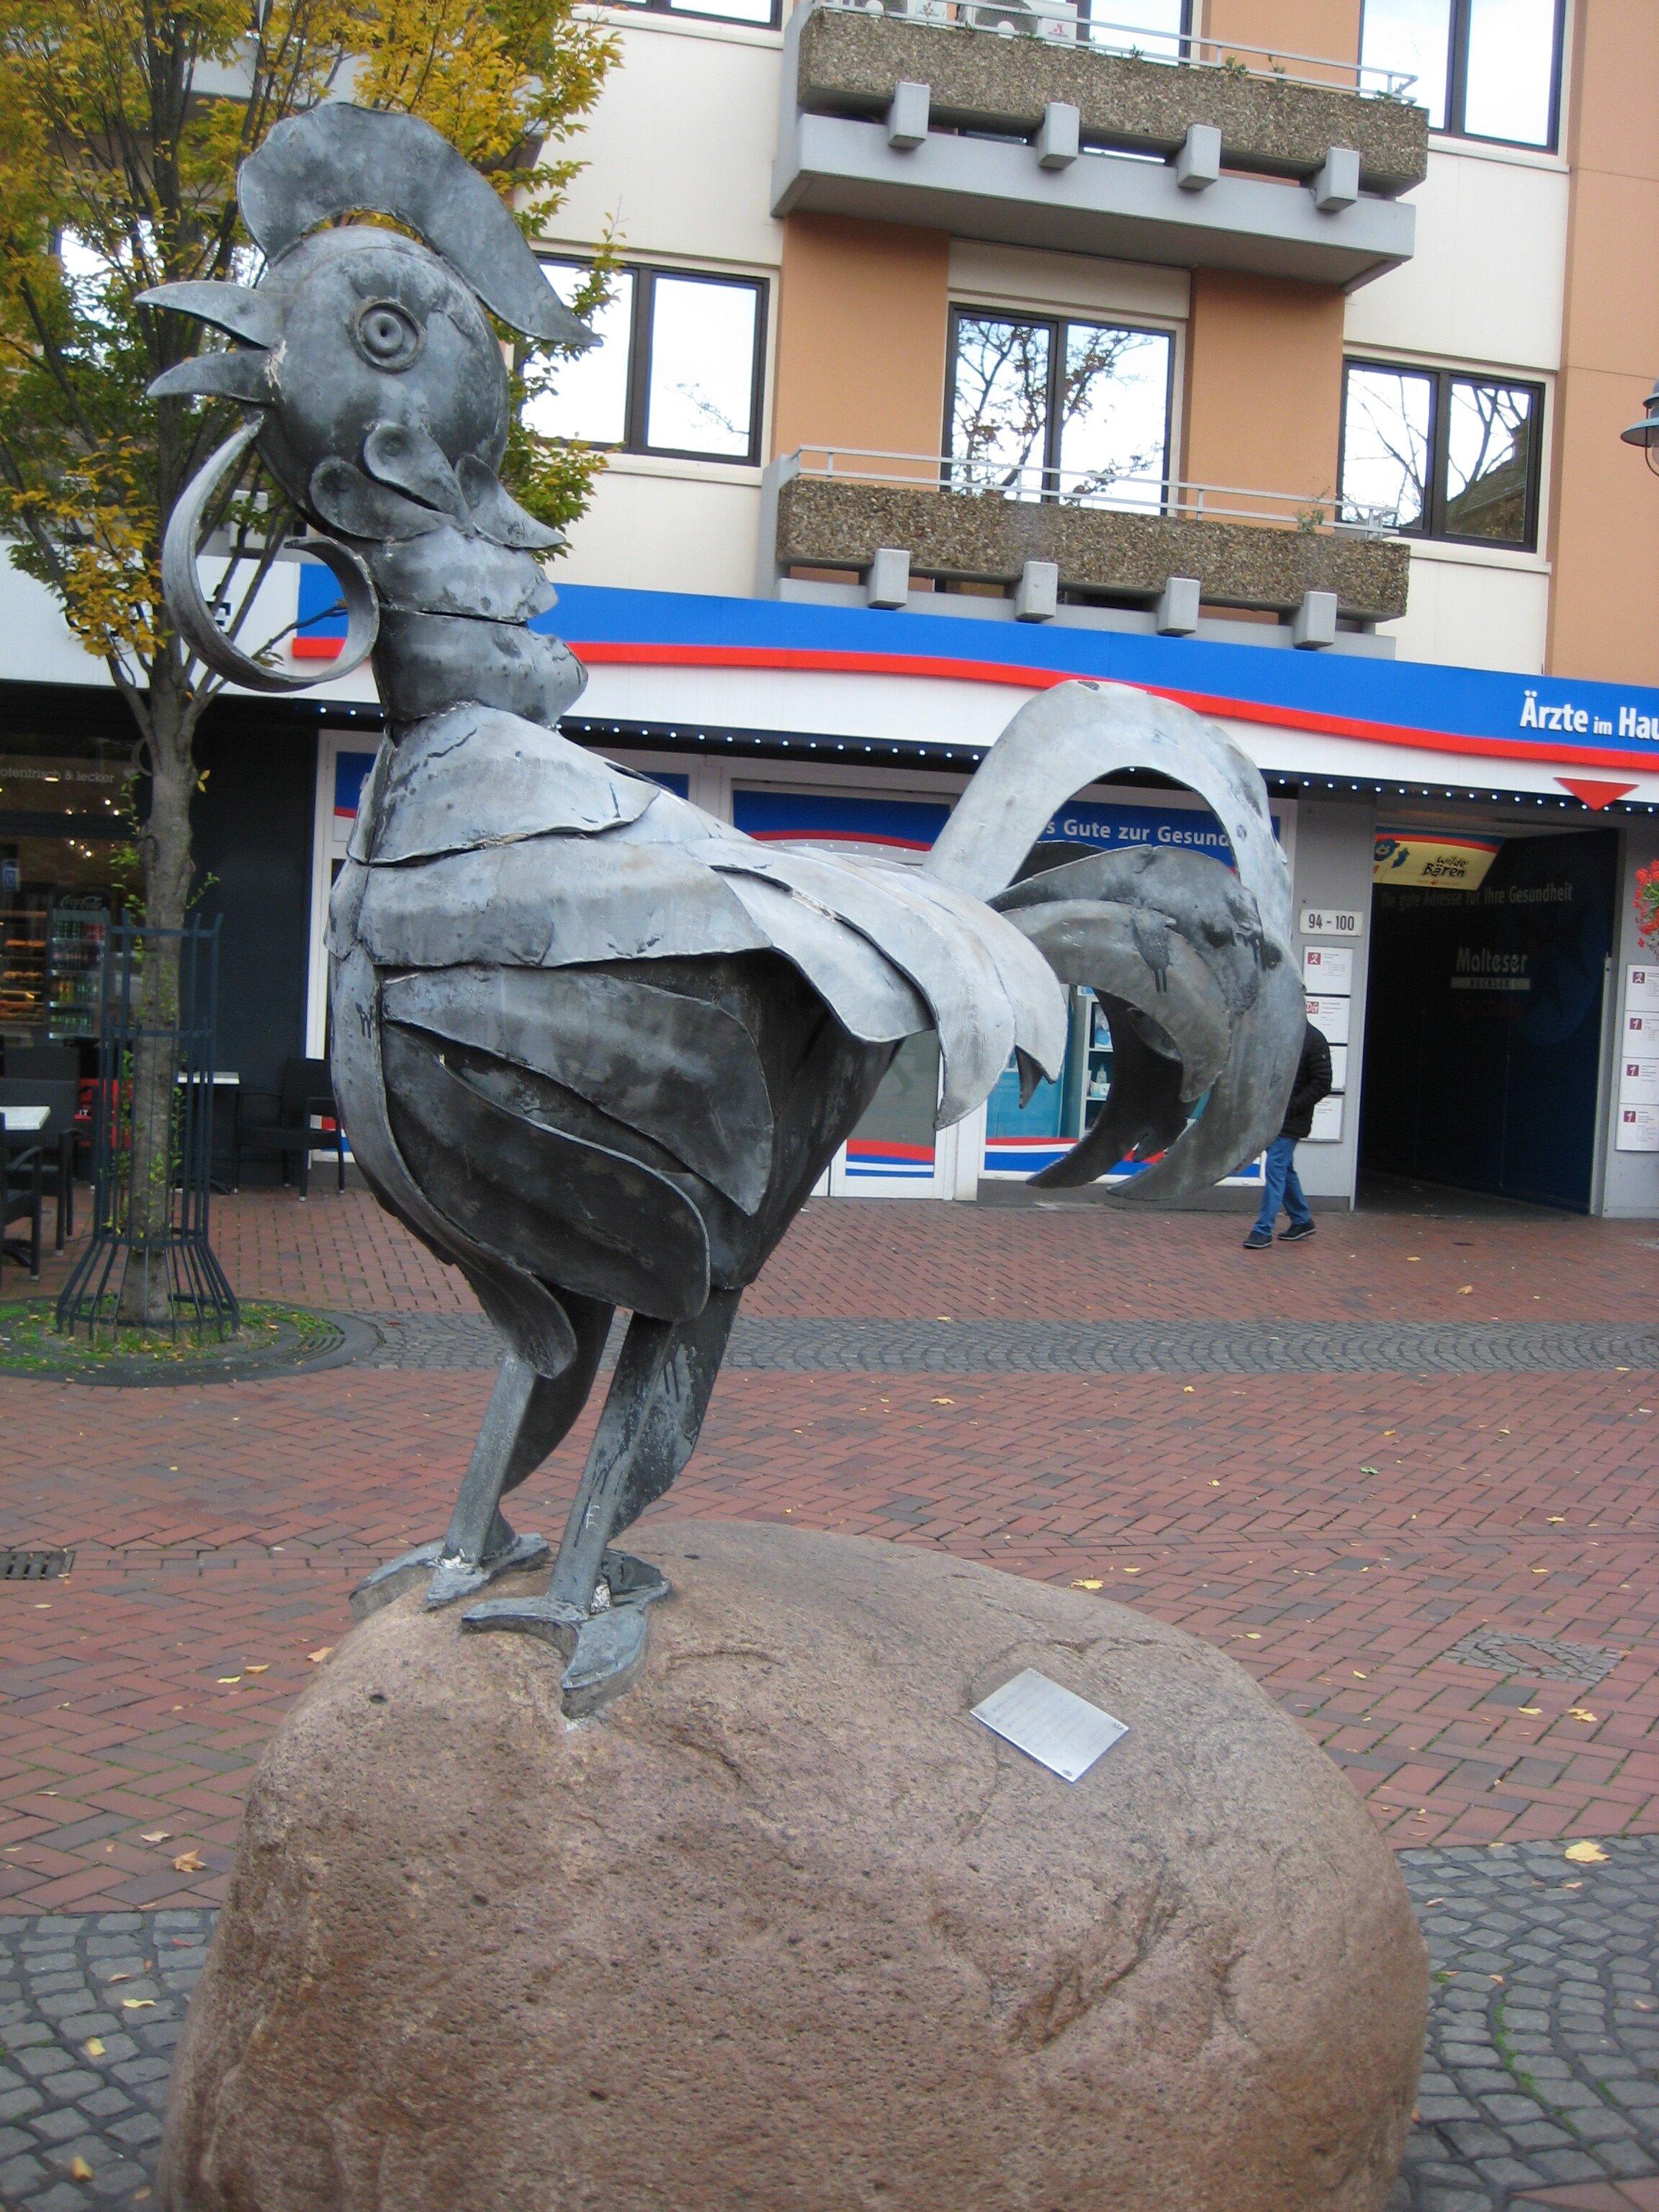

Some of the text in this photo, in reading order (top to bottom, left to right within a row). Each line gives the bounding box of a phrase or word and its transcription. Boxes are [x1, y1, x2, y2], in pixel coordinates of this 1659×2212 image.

[1519, 690, 1589, 733] Ärzte
[1593, 716, 1613, 735] im
[65, 769, 74, 781] &
[76, 770, 115, 783] lecker
[1064, 819, 1111, 839] Gute
[1118, 827, 1150, 841] zur
[1422, 863, 1465, 878] Bären
[1484, 886, 1505, 904] Ihre
[1509, 882, 1573, 904] Gesundheit
[1308, 913, 1323, 929] 94
[1336, 914, 1355, 931] 100
[1456, 947, 1527, 974] Malteser
